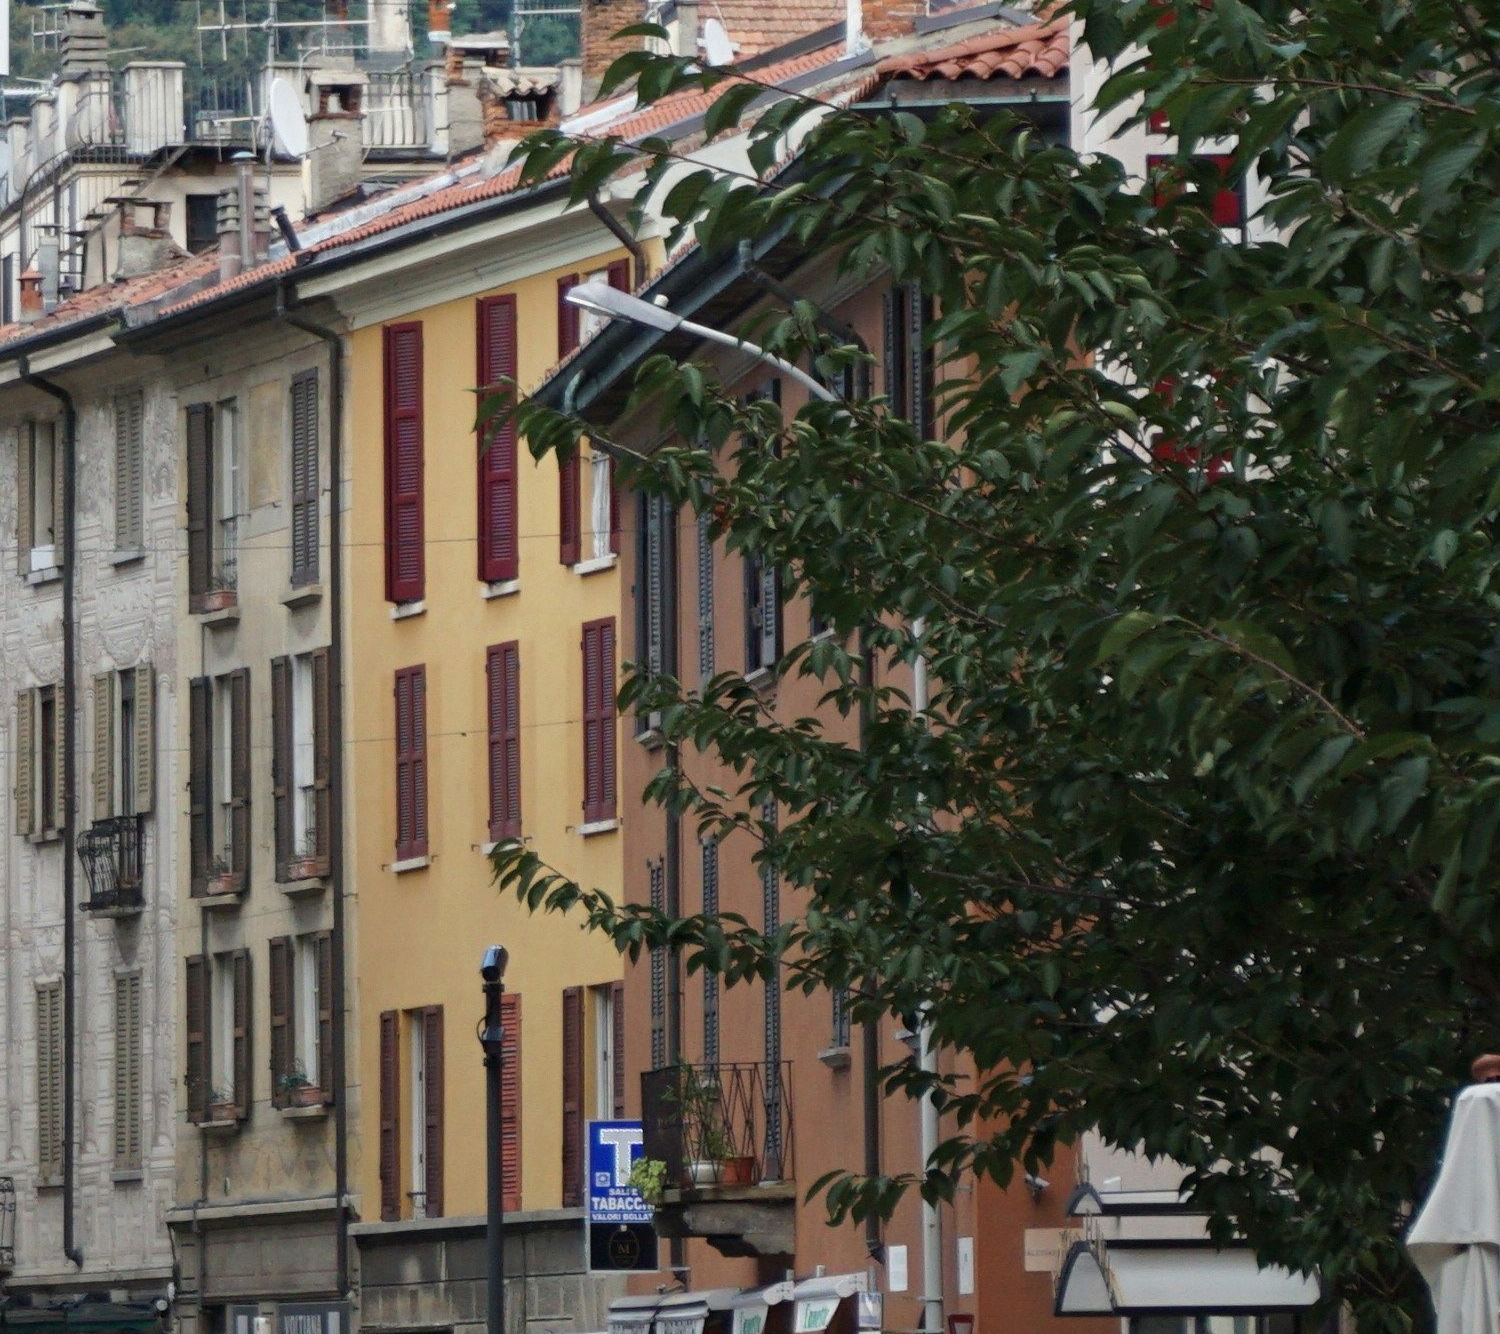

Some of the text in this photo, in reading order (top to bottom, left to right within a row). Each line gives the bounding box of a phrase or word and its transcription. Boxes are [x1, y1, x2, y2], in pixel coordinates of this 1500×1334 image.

[600, 1128, 643, 1187] T
[591, 1196, 656, 1210] TABACC
[592, 1213, 655, 1221] VALORI BOLLAT
